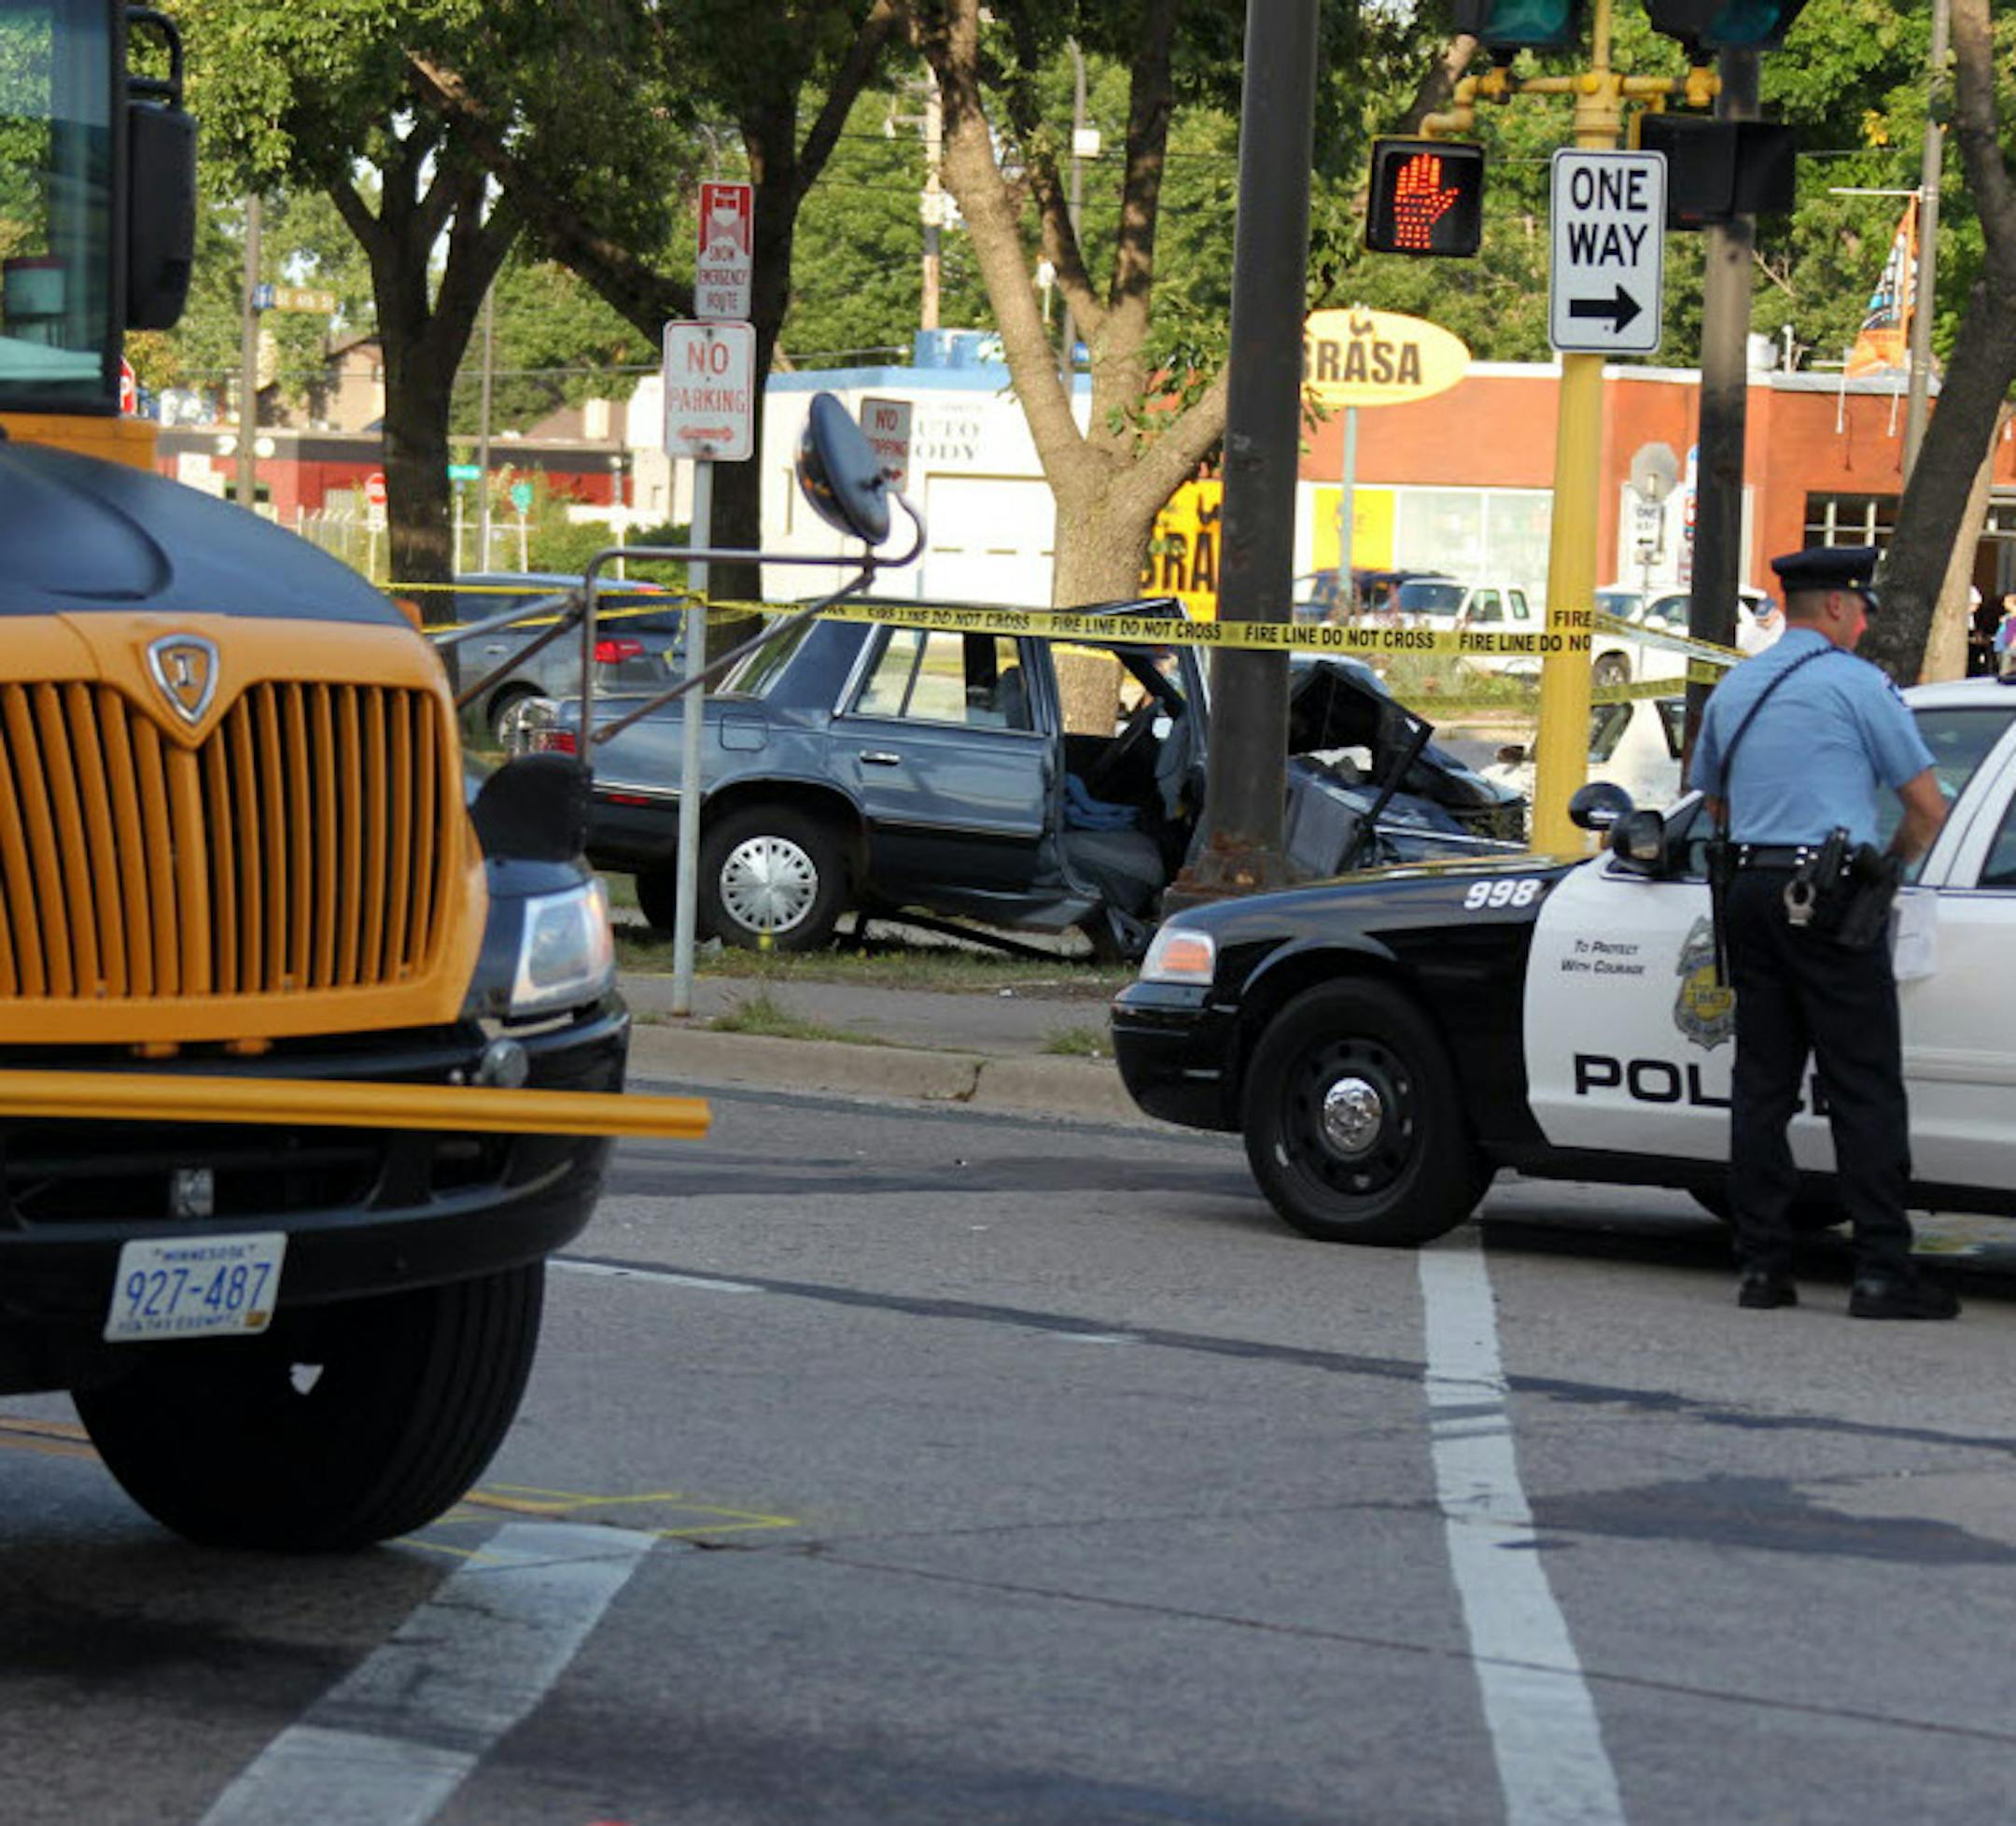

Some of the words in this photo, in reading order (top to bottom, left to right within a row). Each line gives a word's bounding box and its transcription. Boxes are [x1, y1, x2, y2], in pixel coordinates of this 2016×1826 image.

[1571, 167, 1647, 212] ONE
[1568, 221, 1647, 266] WAY
[687, 342, 730, 375] NO
[669, 388, 747, 413] PARKING
[875, 409, 899, 430] NO
[917, 420, 980, 437] UTO
[916, 442, 977, 459] ODY
[931, 611, 952, 625] DO
[955, 613, 982, 627] NOT
[986, 613, 1030, 630] CROSS
[1050, 616, 1081, 633] FIRE
[1085, 618, 1116, 635] LINE
[1120, 620, 1141, 636] DO
[1142, 621, 1172, 638] NOT
[1176, 623, 1222, 640] CROSS
[1244, 625, 1278, 643] FIRE
[1282, 626, 1316, 644] LINE
[1323, 629, 1342, 645] DO
[1348, 630, 1378, 647] NOT
[1383, 631, 1435, 649] CROSS
[1459, 633, 1494, 651] FIRE
[1499, 635, 1535, 652] LINE
[1540, 635, 1561, 652] DO
[1569, 635, 1591, 652] NO
[1553, 611, 1591, 627] FIRE
[1464, 878, 1541, 909] 998
[126, 1264, 272, 1318] 927-487
